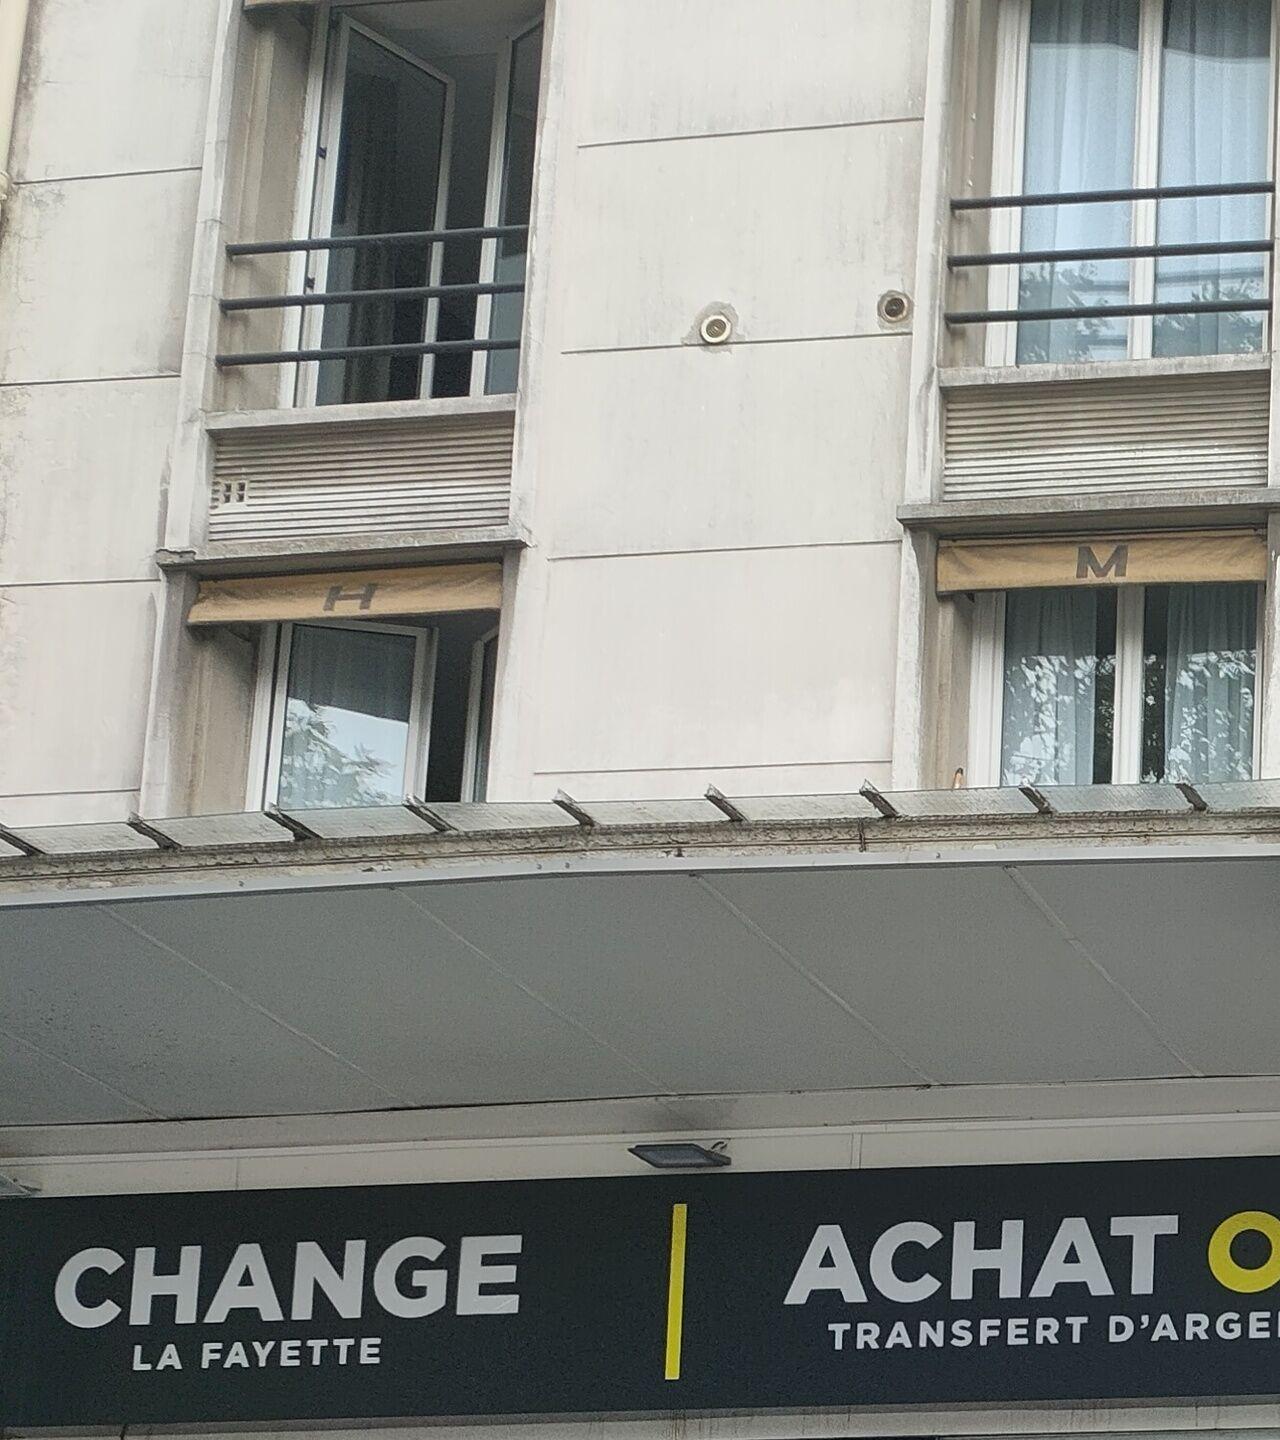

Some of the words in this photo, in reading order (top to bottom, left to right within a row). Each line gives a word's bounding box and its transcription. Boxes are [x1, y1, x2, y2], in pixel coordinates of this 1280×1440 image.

[1076, 545, 1128, 579] M
[323, 584, 378, 611] H
[784, 1215, 1179, 1305] ACHAT
[54, 1235, 522, 1329] CHANGE
[827, 1316, 1090, 1351] TRANSFERT
[133, 1344, 182, 1371] LA
[201, 1337, 382, 1369] FAYETTE
